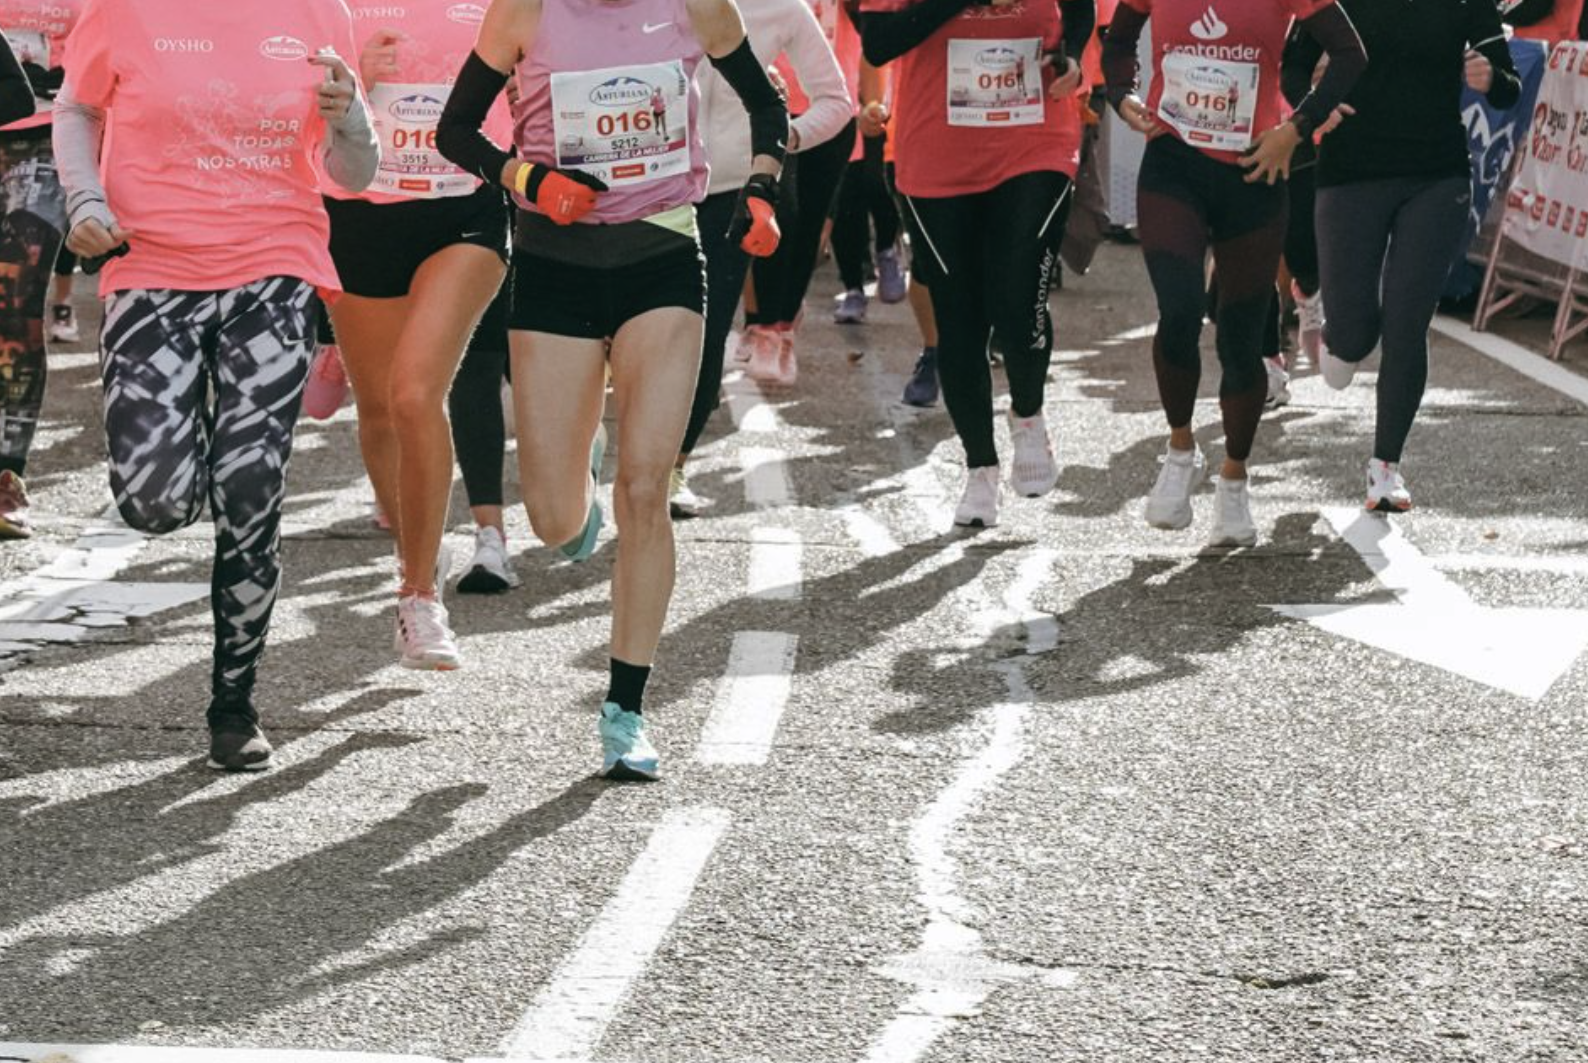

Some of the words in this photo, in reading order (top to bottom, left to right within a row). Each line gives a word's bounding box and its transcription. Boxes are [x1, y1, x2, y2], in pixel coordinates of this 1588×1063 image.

[353, 6, 406, 19] OYSHO
[154, 38, 214, 53] OYSHO
[979, 73, 1016, 90] 016
[1186, 91, 1226, 112] 016
[259, 119, 300, 133] POR
[596, 110, 652, 137] 016
[233, 136, 296, 150] TODAS
[611, 137, 639, 150] 5212
[402, 153, 429, 165] 3515
[1032, 247, 1054, 337] Santander
